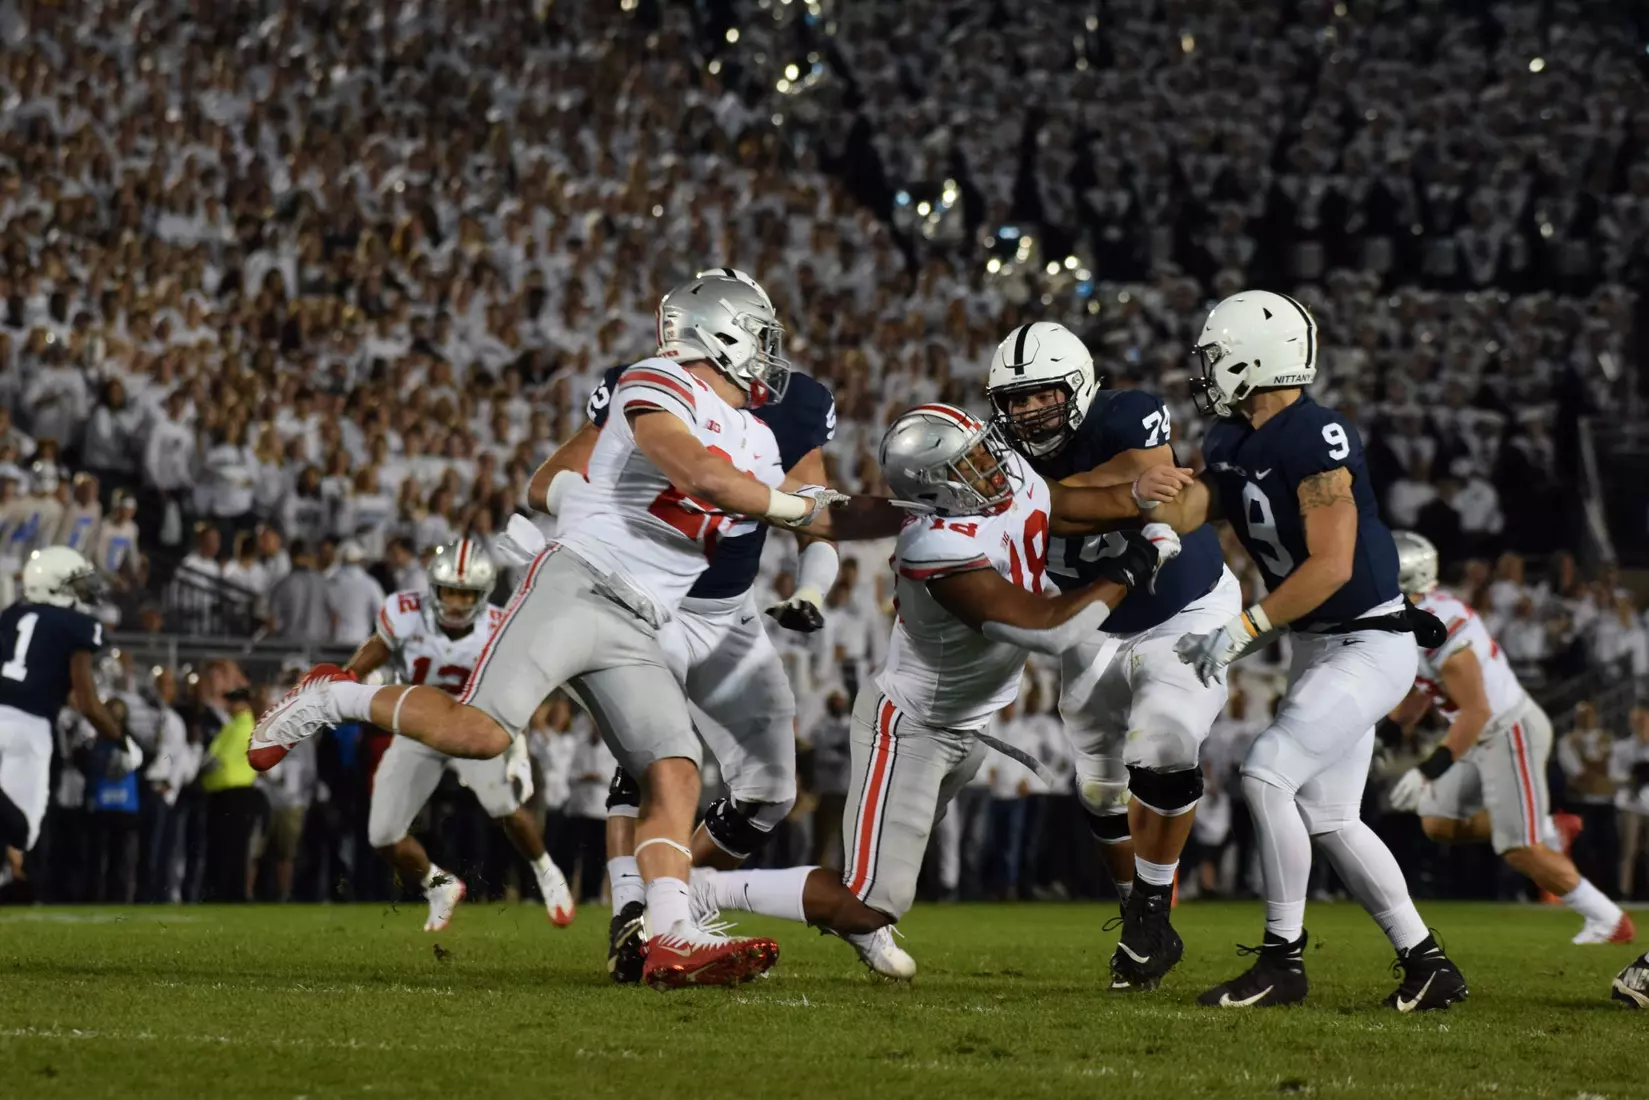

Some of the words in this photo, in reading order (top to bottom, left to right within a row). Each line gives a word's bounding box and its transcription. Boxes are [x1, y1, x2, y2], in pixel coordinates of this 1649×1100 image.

[1142, 404, 1171, 447] 74
[1321, 422, 1349, 460] 9
[1242, 481, 1294, 578] 9
[2, 612, 39, 682] 1
[92, 622, 102, 646] 1
[411, 656, 473, 696] 12
